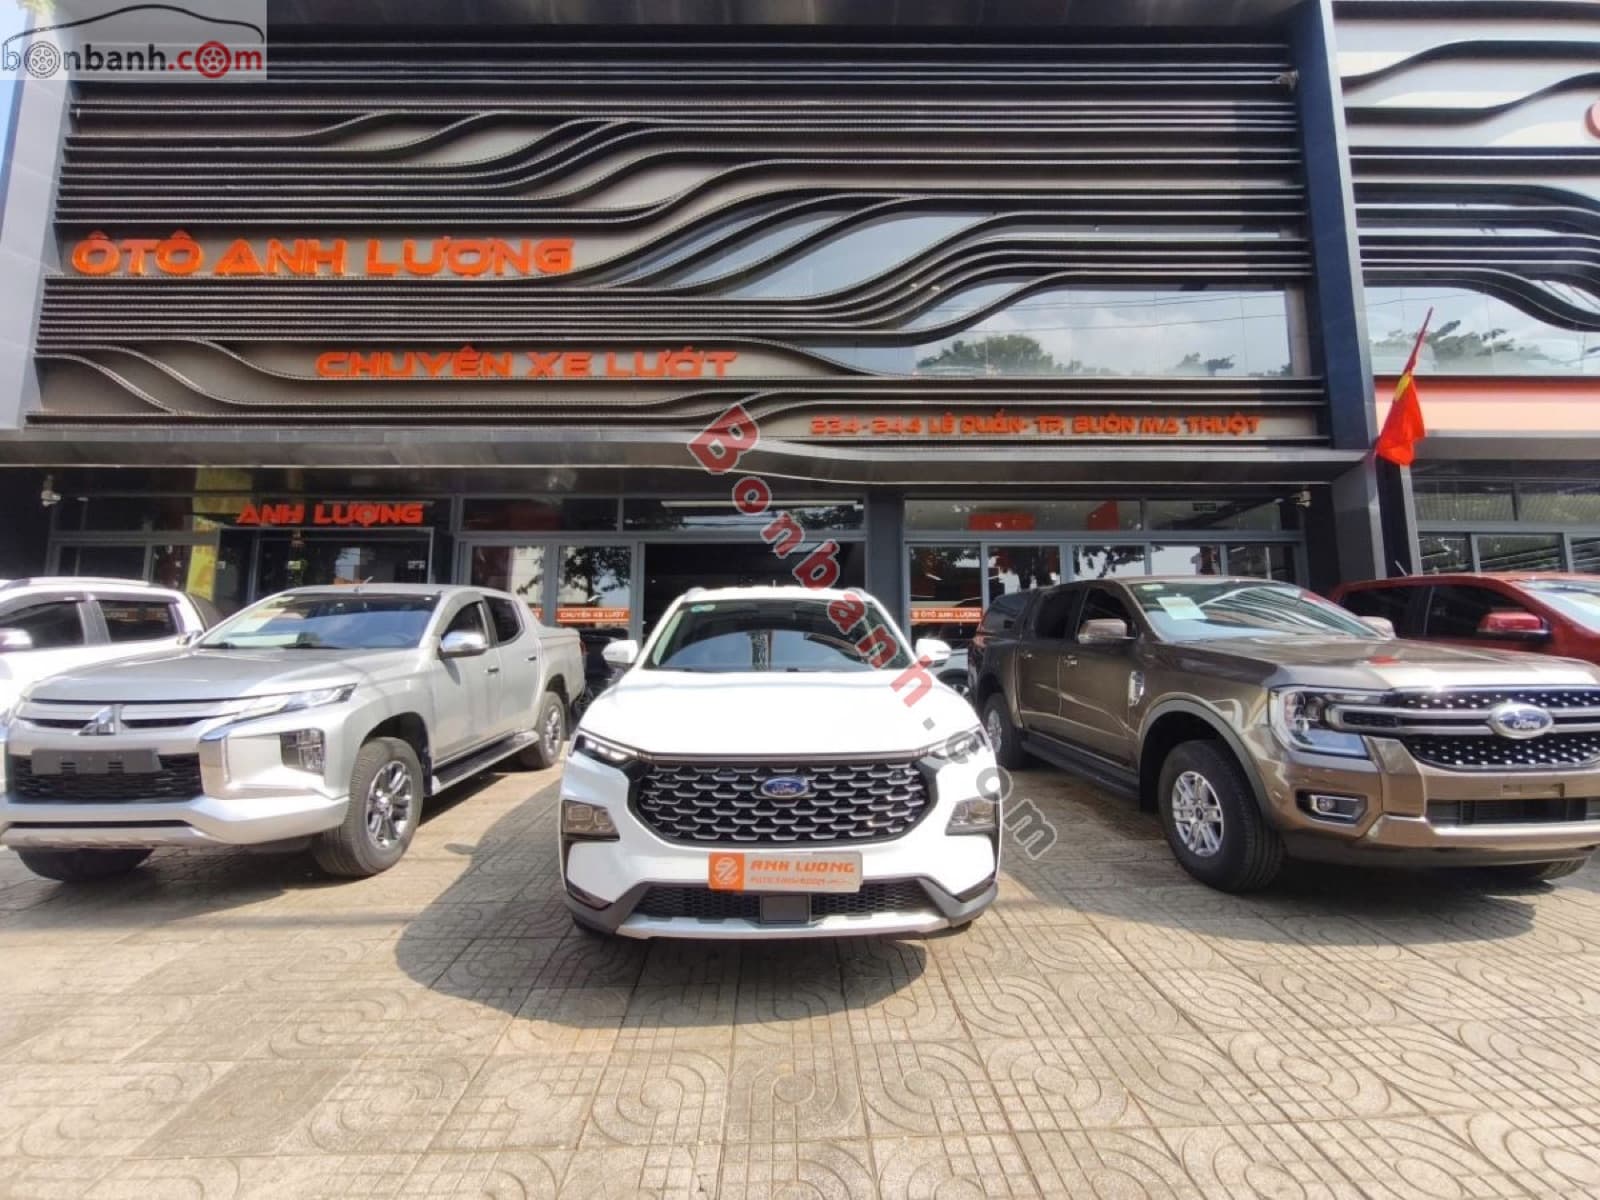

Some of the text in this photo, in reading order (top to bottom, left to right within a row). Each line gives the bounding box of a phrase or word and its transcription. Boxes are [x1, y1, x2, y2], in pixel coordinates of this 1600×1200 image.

[72, 230, 204, 275] ÔTÔ
[213, 238, 348, 276] ANH
[316, 346, 512, 378] CHUYÊN
[526, 351, 592, 378] XE
[928, 411, 955, 434] LÊ
[1072, 412, 1135, 434] BUÔN
[1139, 416, 1180, 434] MA
[1187, 412, 1260, 436] THUỘT
[236, 503, 305, 524] ANH
[751, 860, 789, 872] ANH
